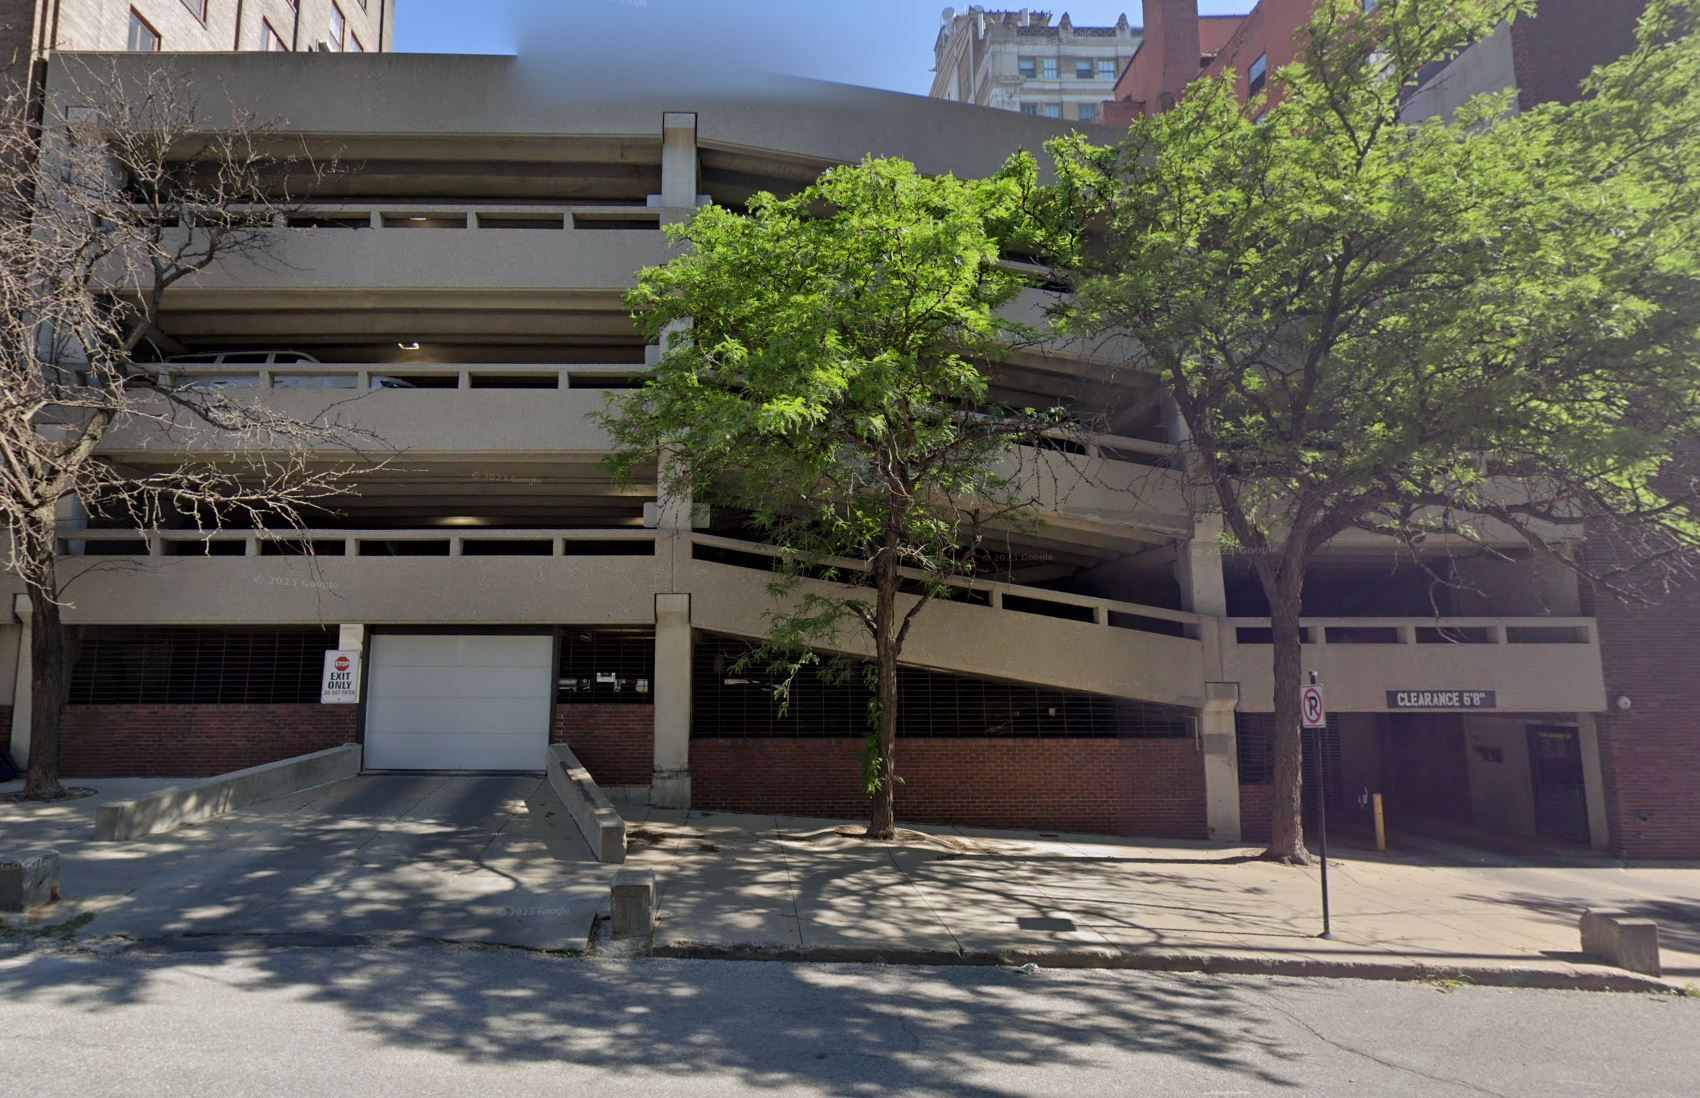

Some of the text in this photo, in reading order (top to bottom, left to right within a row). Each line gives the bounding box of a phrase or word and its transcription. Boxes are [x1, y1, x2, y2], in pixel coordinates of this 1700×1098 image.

[336, 660, 350, 668] STOP
[330, 672, 351, 681] EXIT
[327, 681, 353, 690] ONLY
[1396, 692, 1486, 707] CLEARANCE 6'8"
